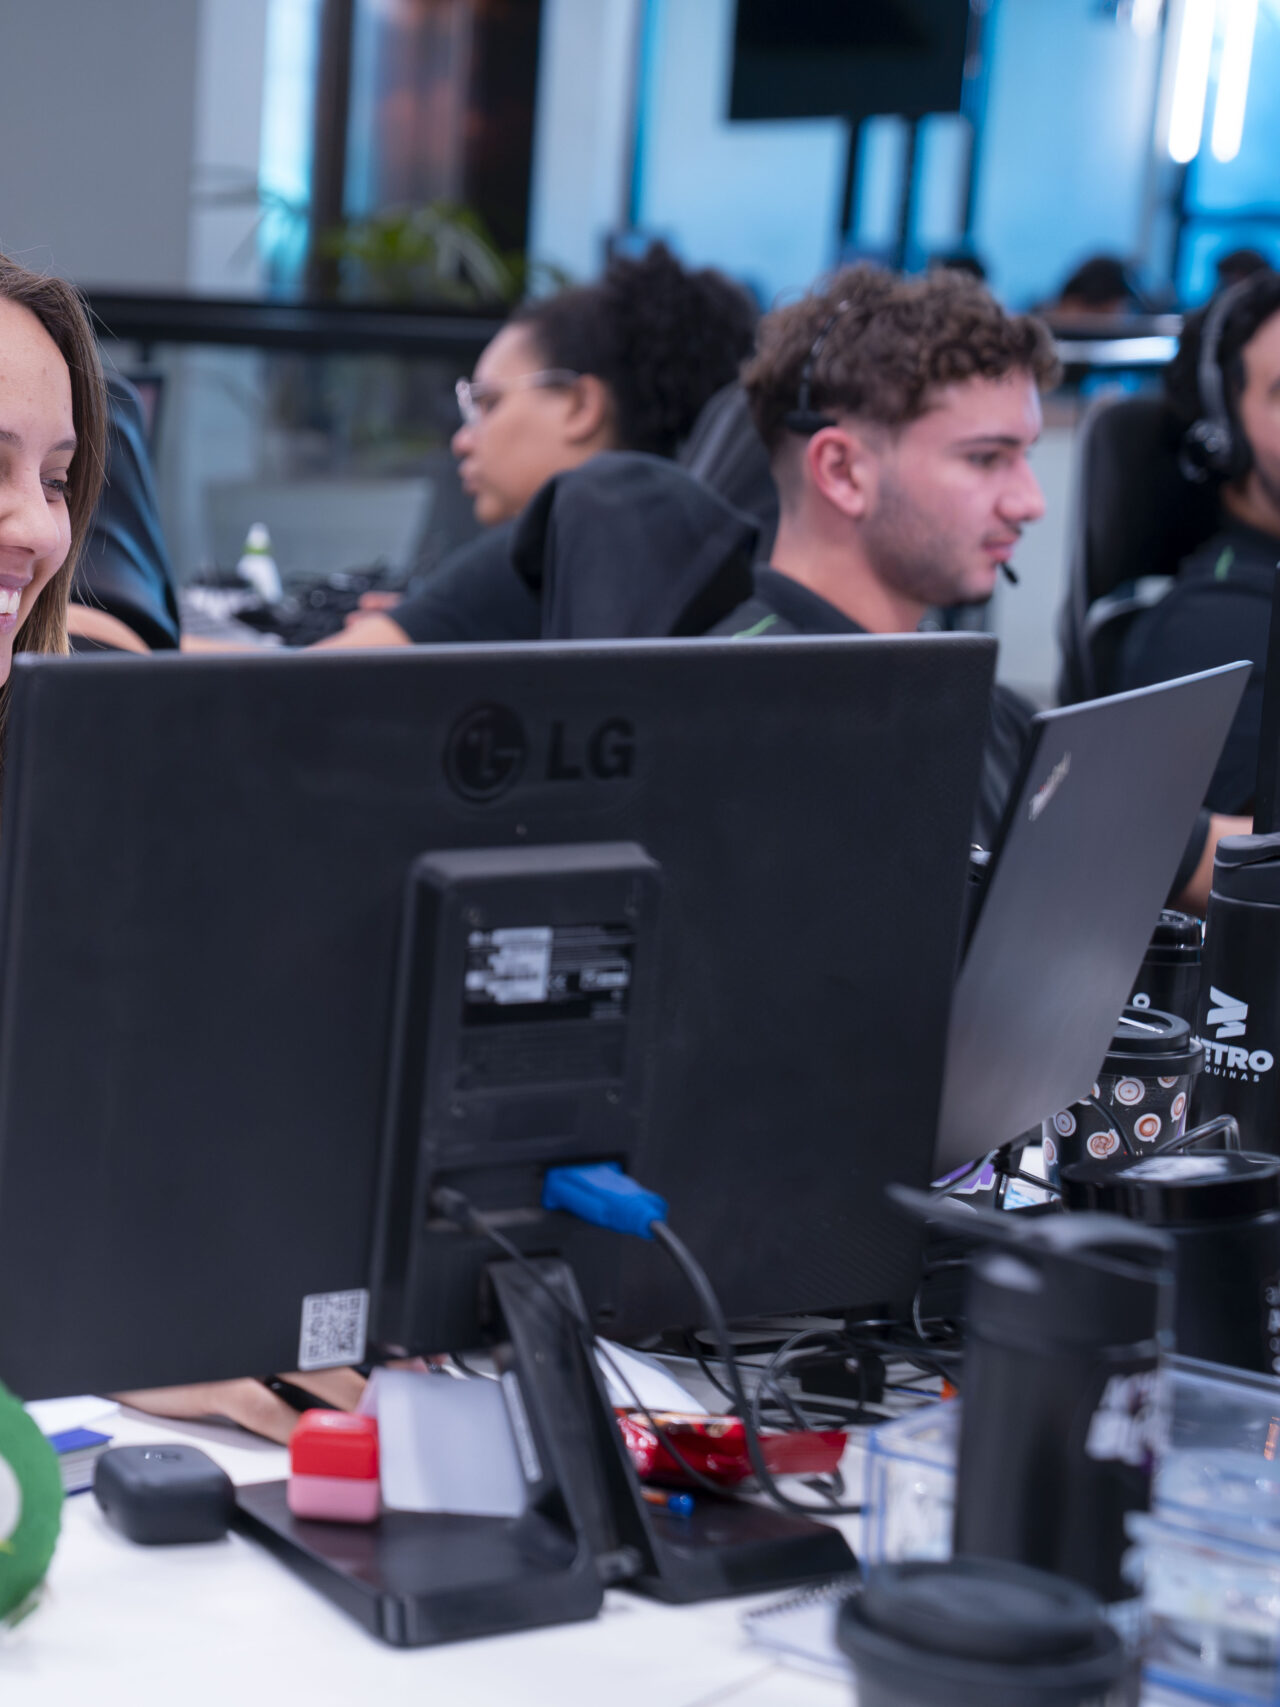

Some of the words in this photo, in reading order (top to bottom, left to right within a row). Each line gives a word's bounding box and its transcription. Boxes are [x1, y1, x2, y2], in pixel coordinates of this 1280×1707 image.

[545, 716, 637, 780] LG
[1195, 1035, 1274, 1073] ETRO
[1204, 1064, 1261, 1083] QUINAS
